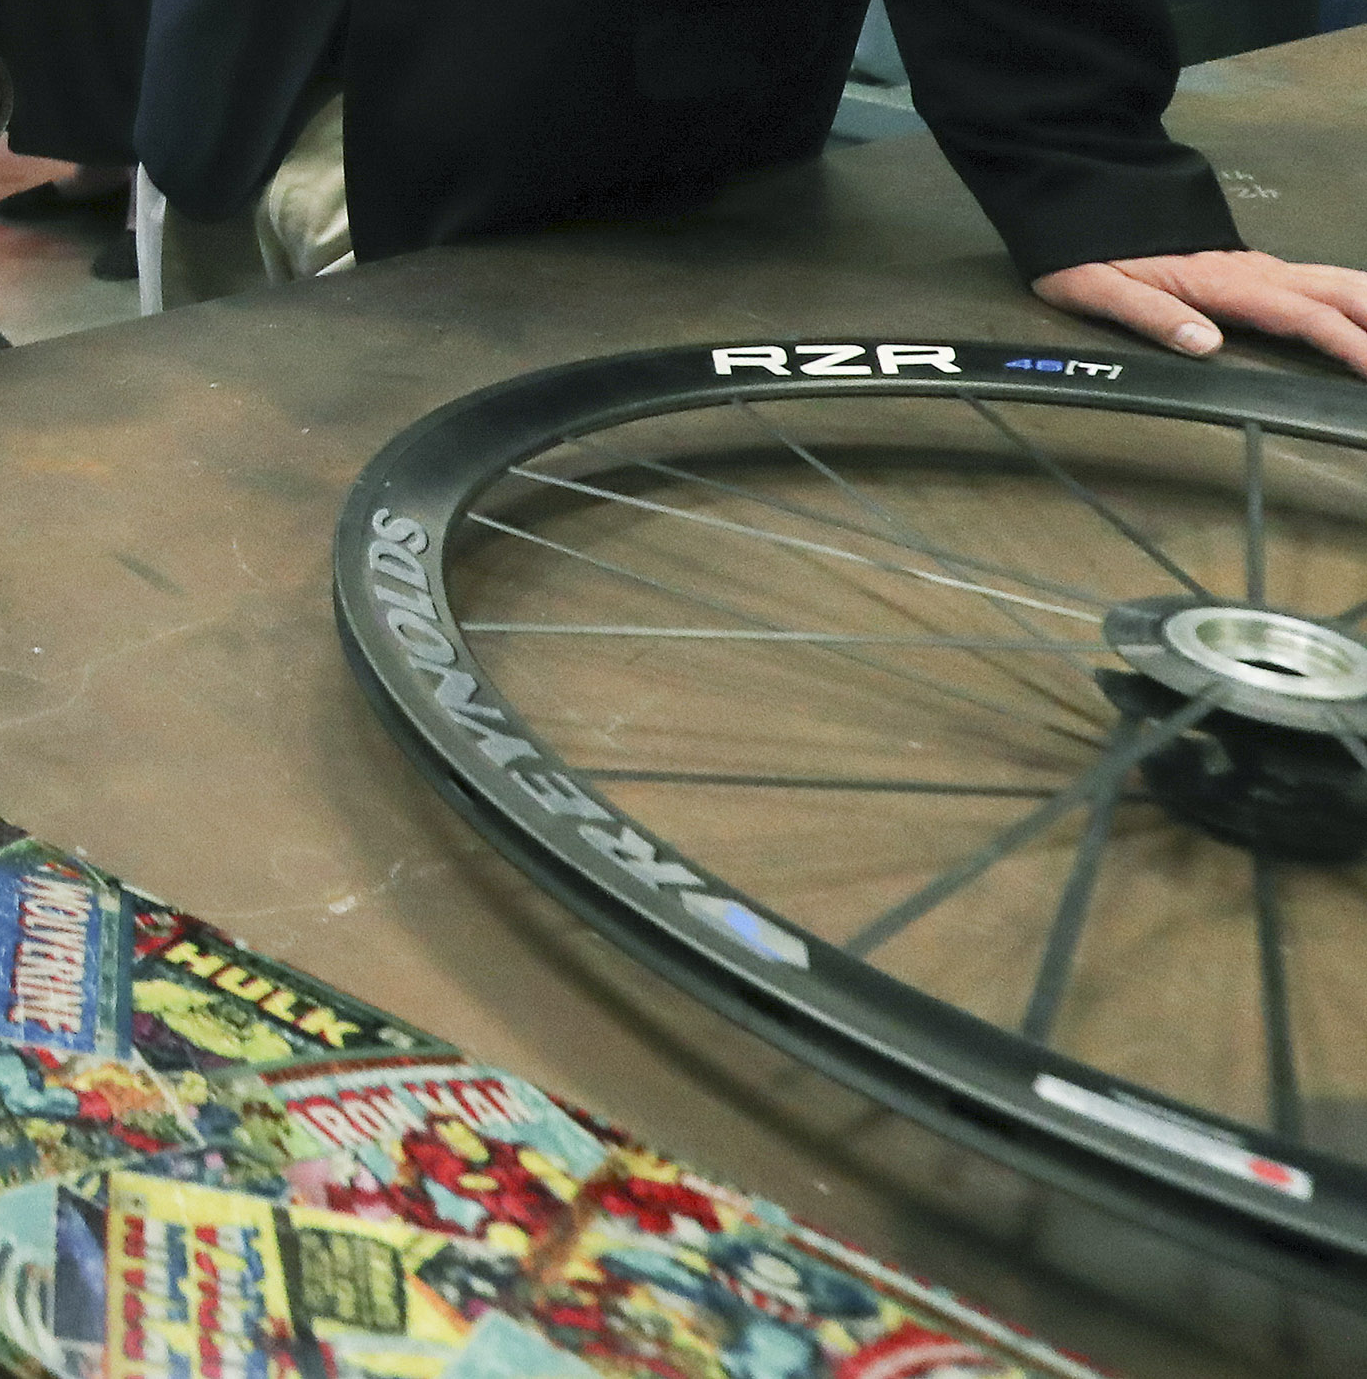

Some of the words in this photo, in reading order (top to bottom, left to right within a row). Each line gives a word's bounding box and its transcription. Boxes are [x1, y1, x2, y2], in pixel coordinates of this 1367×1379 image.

[712, 344, 963, 377] RZR
[368, 508, 706, 890] REYNOLDS
[9, 874, 93, 1033] WOLVERINE
[166, 941, 361, 1049] HULK
[287, 1084, 425, 1146] IRON
[405, 1078, 533, 1126] MAN
